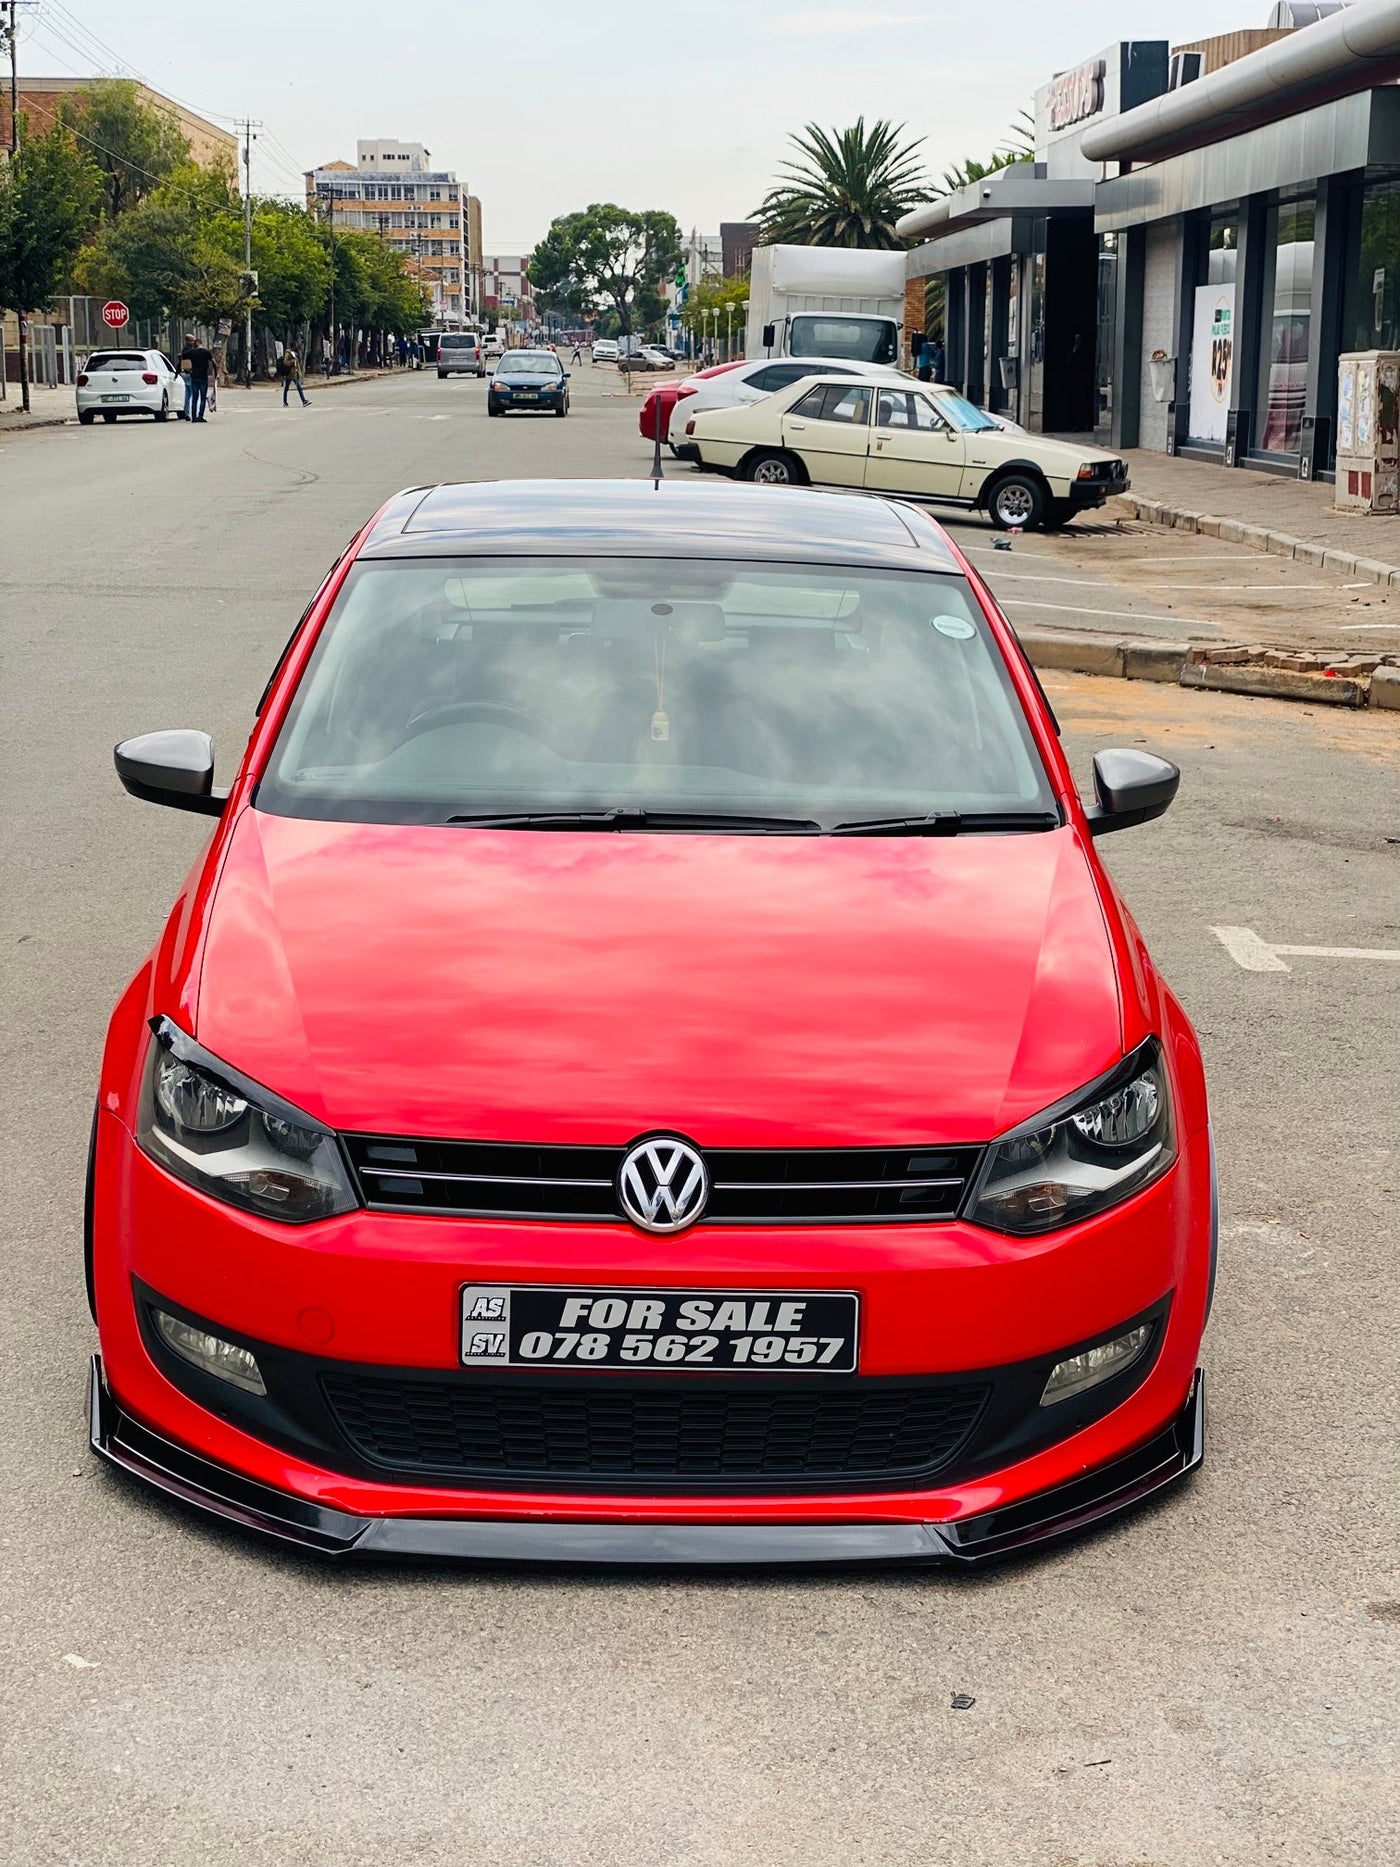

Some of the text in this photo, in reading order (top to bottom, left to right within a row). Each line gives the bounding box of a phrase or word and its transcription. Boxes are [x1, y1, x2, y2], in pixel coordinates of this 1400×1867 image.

[105, 309, 126, 320] STOP
[470, 1297, 505, 1317] AS
[559, 1298, 807, 1332] FOR SALE
[470, 1333, 505, 1353] SV
[518, 1331, 845, 1364] 078 562 1957
